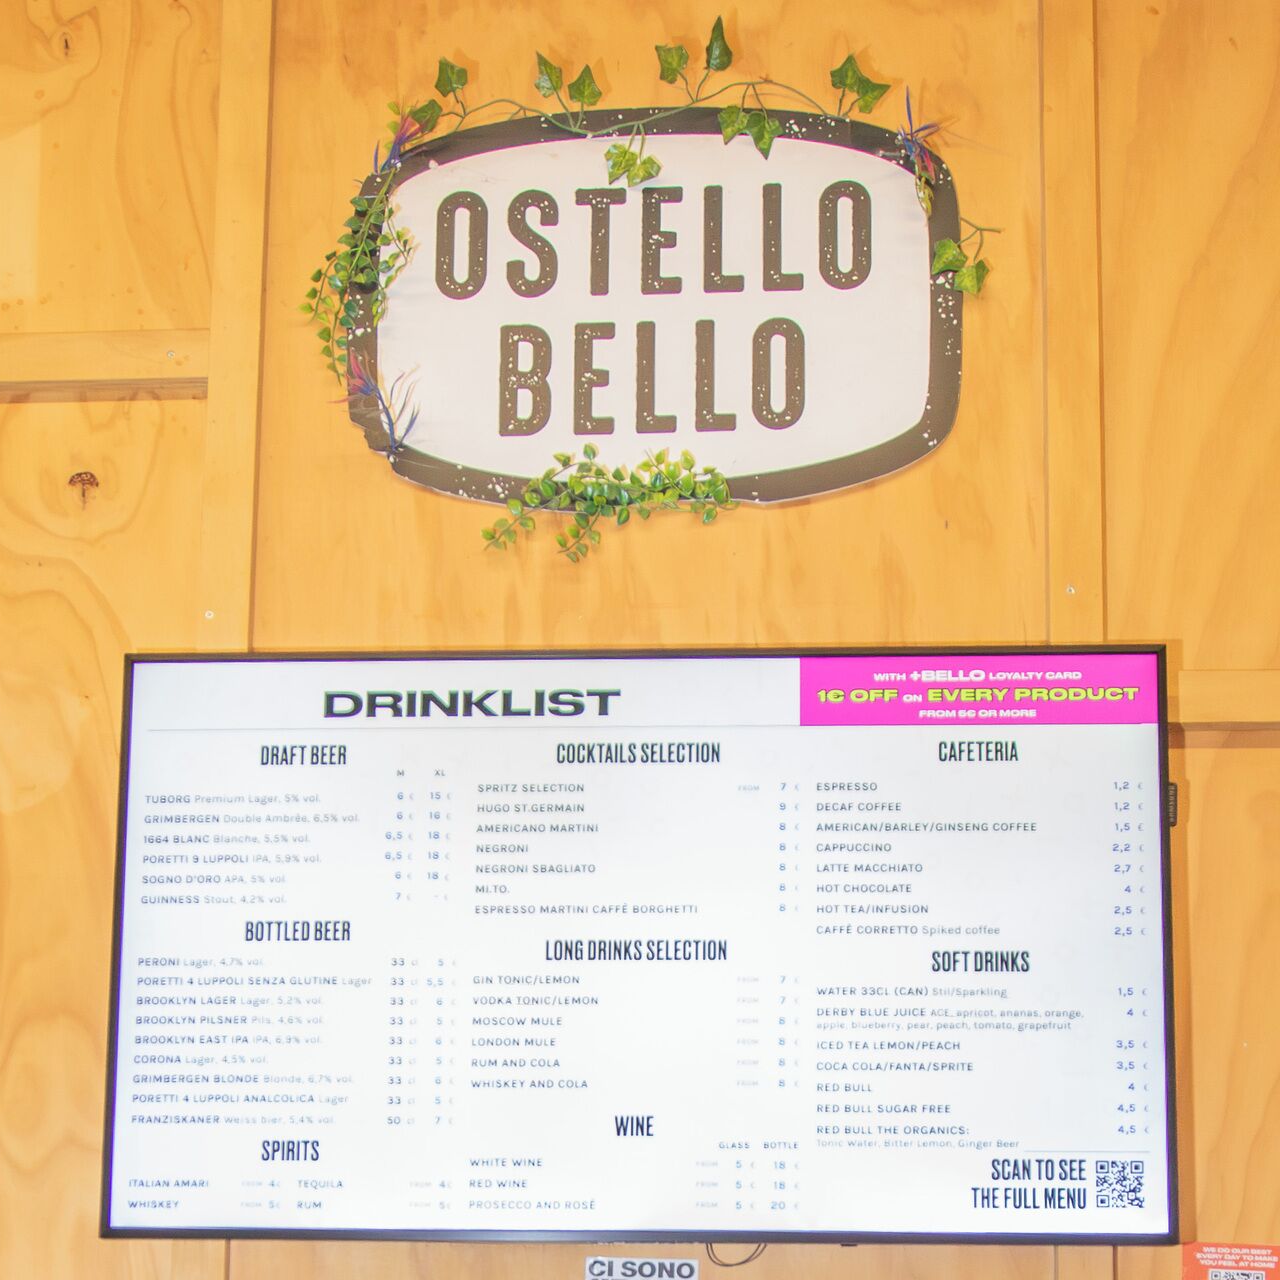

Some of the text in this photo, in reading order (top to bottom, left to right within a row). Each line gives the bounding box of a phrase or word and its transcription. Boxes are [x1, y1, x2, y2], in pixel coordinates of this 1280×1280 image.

[436, 181, 872, 299] OSTELLO
[499, 317, 805, 436] BELLO
[874, 673, 906, 681] WITH
[989, 672, 1043, 680] LOYALTY
[1045, 672, 1082, 680] CARD
[850, 689, 898, 702] OFF
[903, 694, 922, 702] ON
[928, 689, 1007, 701] EVERY
[1014, 688, 1138, 701] PRODUCT
[323, 688, 622, 718] DRINKLIST
[999, 709, 1036, 717] MORE
[260, 745, 347, 765] DRAFT BEER
[557, 742, 720, 764] COCKTAILS SELECTION
[938, 741, 1019, 762] CAFETERIA
[478, 784, 584, 792] SPRITZ SELECTION
[817, 783, 878, 791] ESPRESSO
[145, 795, 190, 804] TUBORG
[144, 815, 220, 823] GRIMBERGEN
[476, 824, 598, 832] AMERICANO MARTINI
[993, 823, 1037, 831] COFFEE
[817, 844, 891, 852] CAPPUCCINO
[143, 855, 188, 864] PORETTI
[203, 855, 248, 864] LUPPOLI
[141, 895, 199, 904] GUINNESS
[475, 905, 536, 914] ESPRESSO
[540, 905, 589, 913] MARTINI
[632, 905, 698, 913] BORGHETTI
[245, 921, 351, 941] BOTTLED BEER
[546, 940, 727, 961] LONG DRINKS SELECTION
[138, 958, 180, 966] PERONI
[932, 951, 1030, 973] SOFT DRINKS
[131, 1116, 220, 1124] FRANZISKANER
[615, 1116, 654, 1136] WINE
[261, 1140, 320, 1161] SPIRITS
[991, 1159, 1086, 1180] SCAN TO SEE
[972, 1188, 1086, 1209] THE FULL MENU
[589, 1260, 695, 1278] CI SONO
